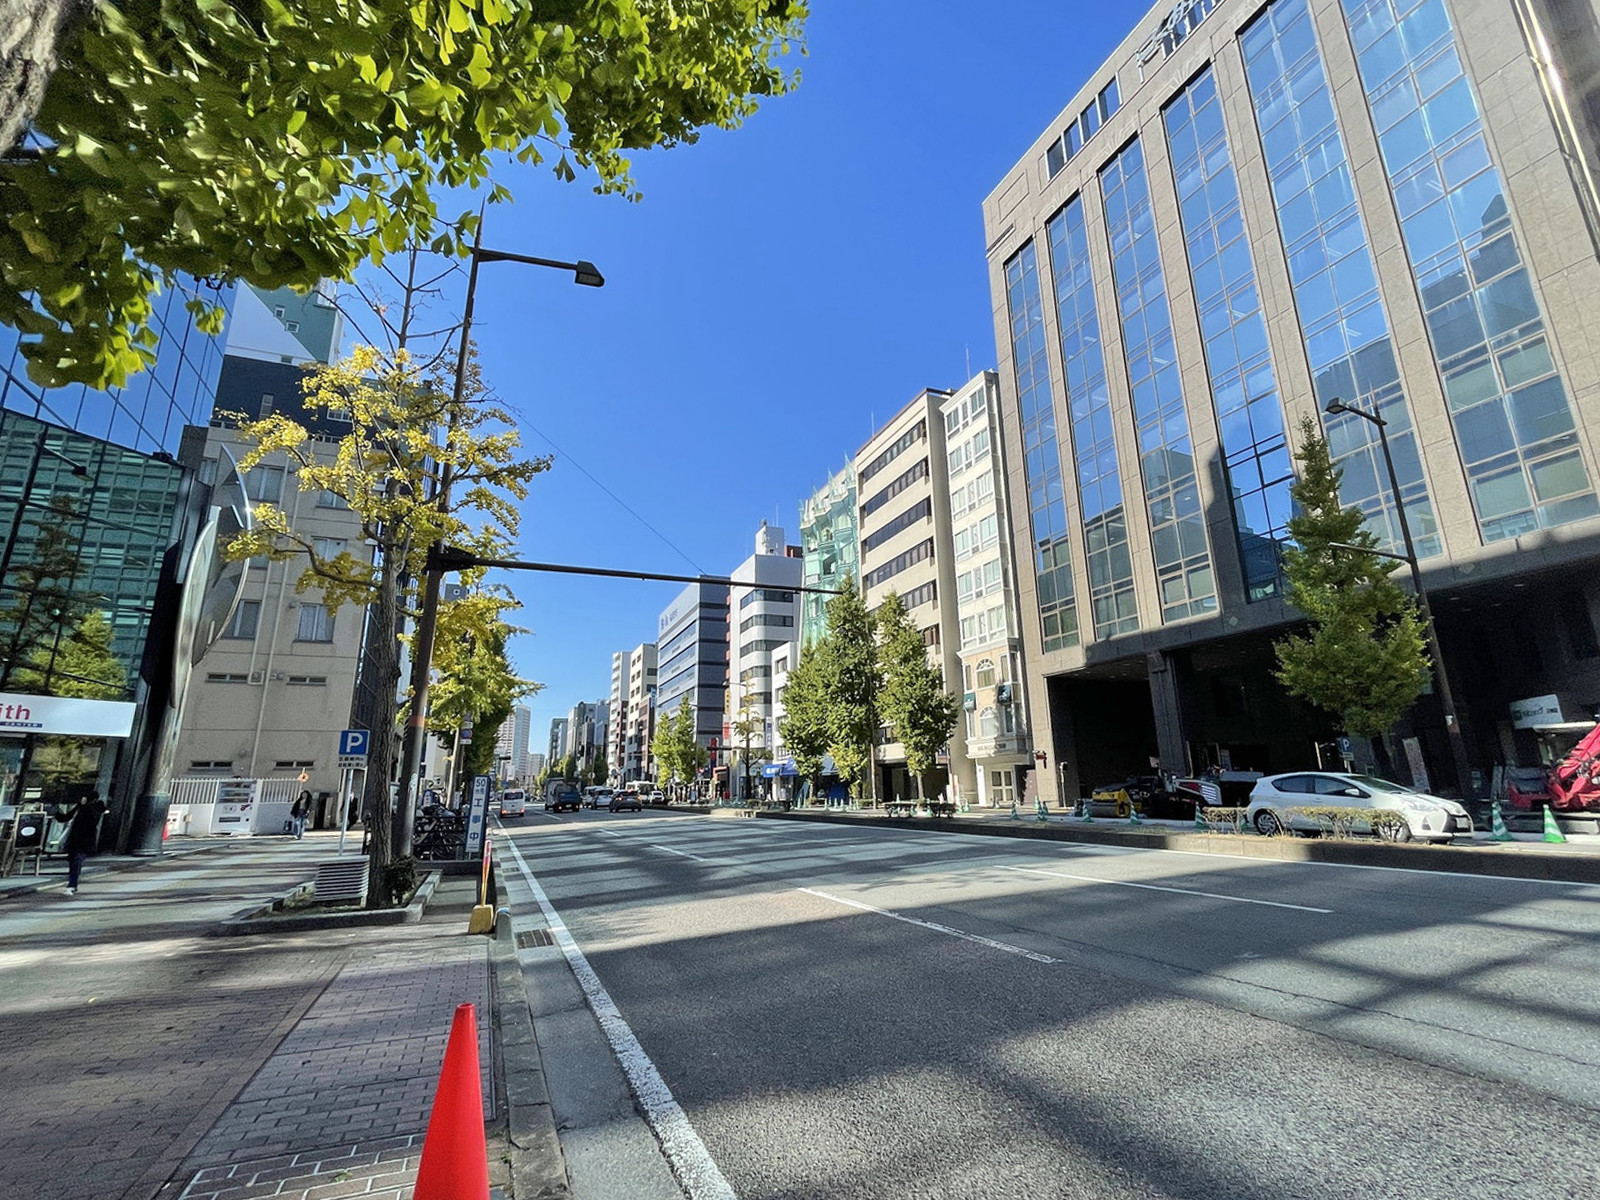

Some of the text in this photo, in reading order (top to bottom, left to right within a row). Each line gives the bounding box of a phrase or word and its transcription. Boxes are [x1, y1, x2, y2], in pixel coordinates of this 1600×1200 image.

[346, 732, 364, 753] P
[1342, 739, 1350, 751] P
[475, 778, 486, 787] 50
